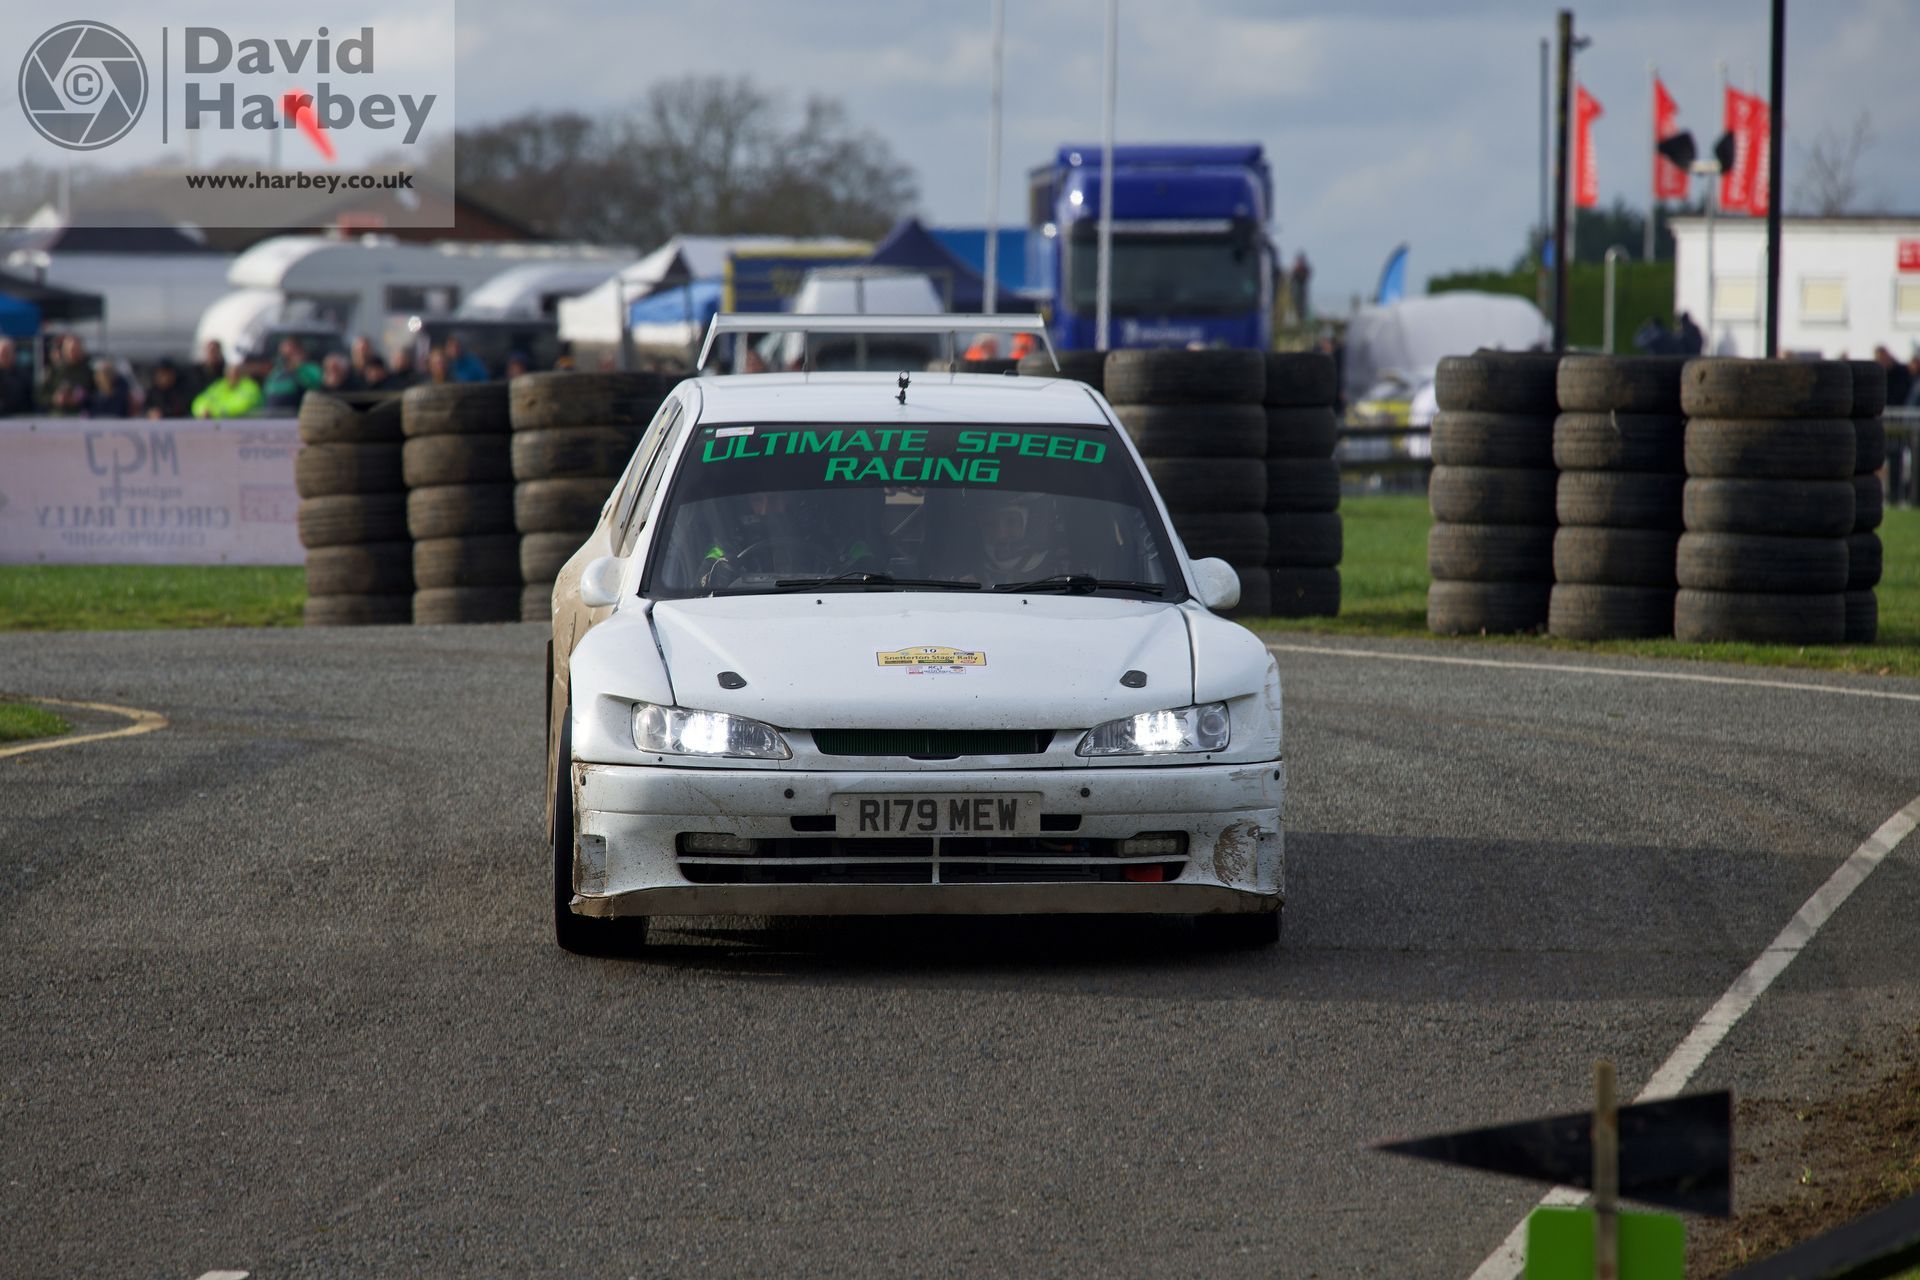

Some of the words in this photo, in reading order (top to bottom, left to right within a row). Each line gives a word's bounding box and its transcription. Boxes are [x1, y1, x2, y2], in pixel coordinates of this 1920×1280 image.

[702, 430, 929, 463] ULTIMATE
[957, 431, 1107, 464] SPEED
[824, 457, 1000, 483] RACING
[859, 799, 938, 832] R179
[950, 799, 1018, 831] MEW
